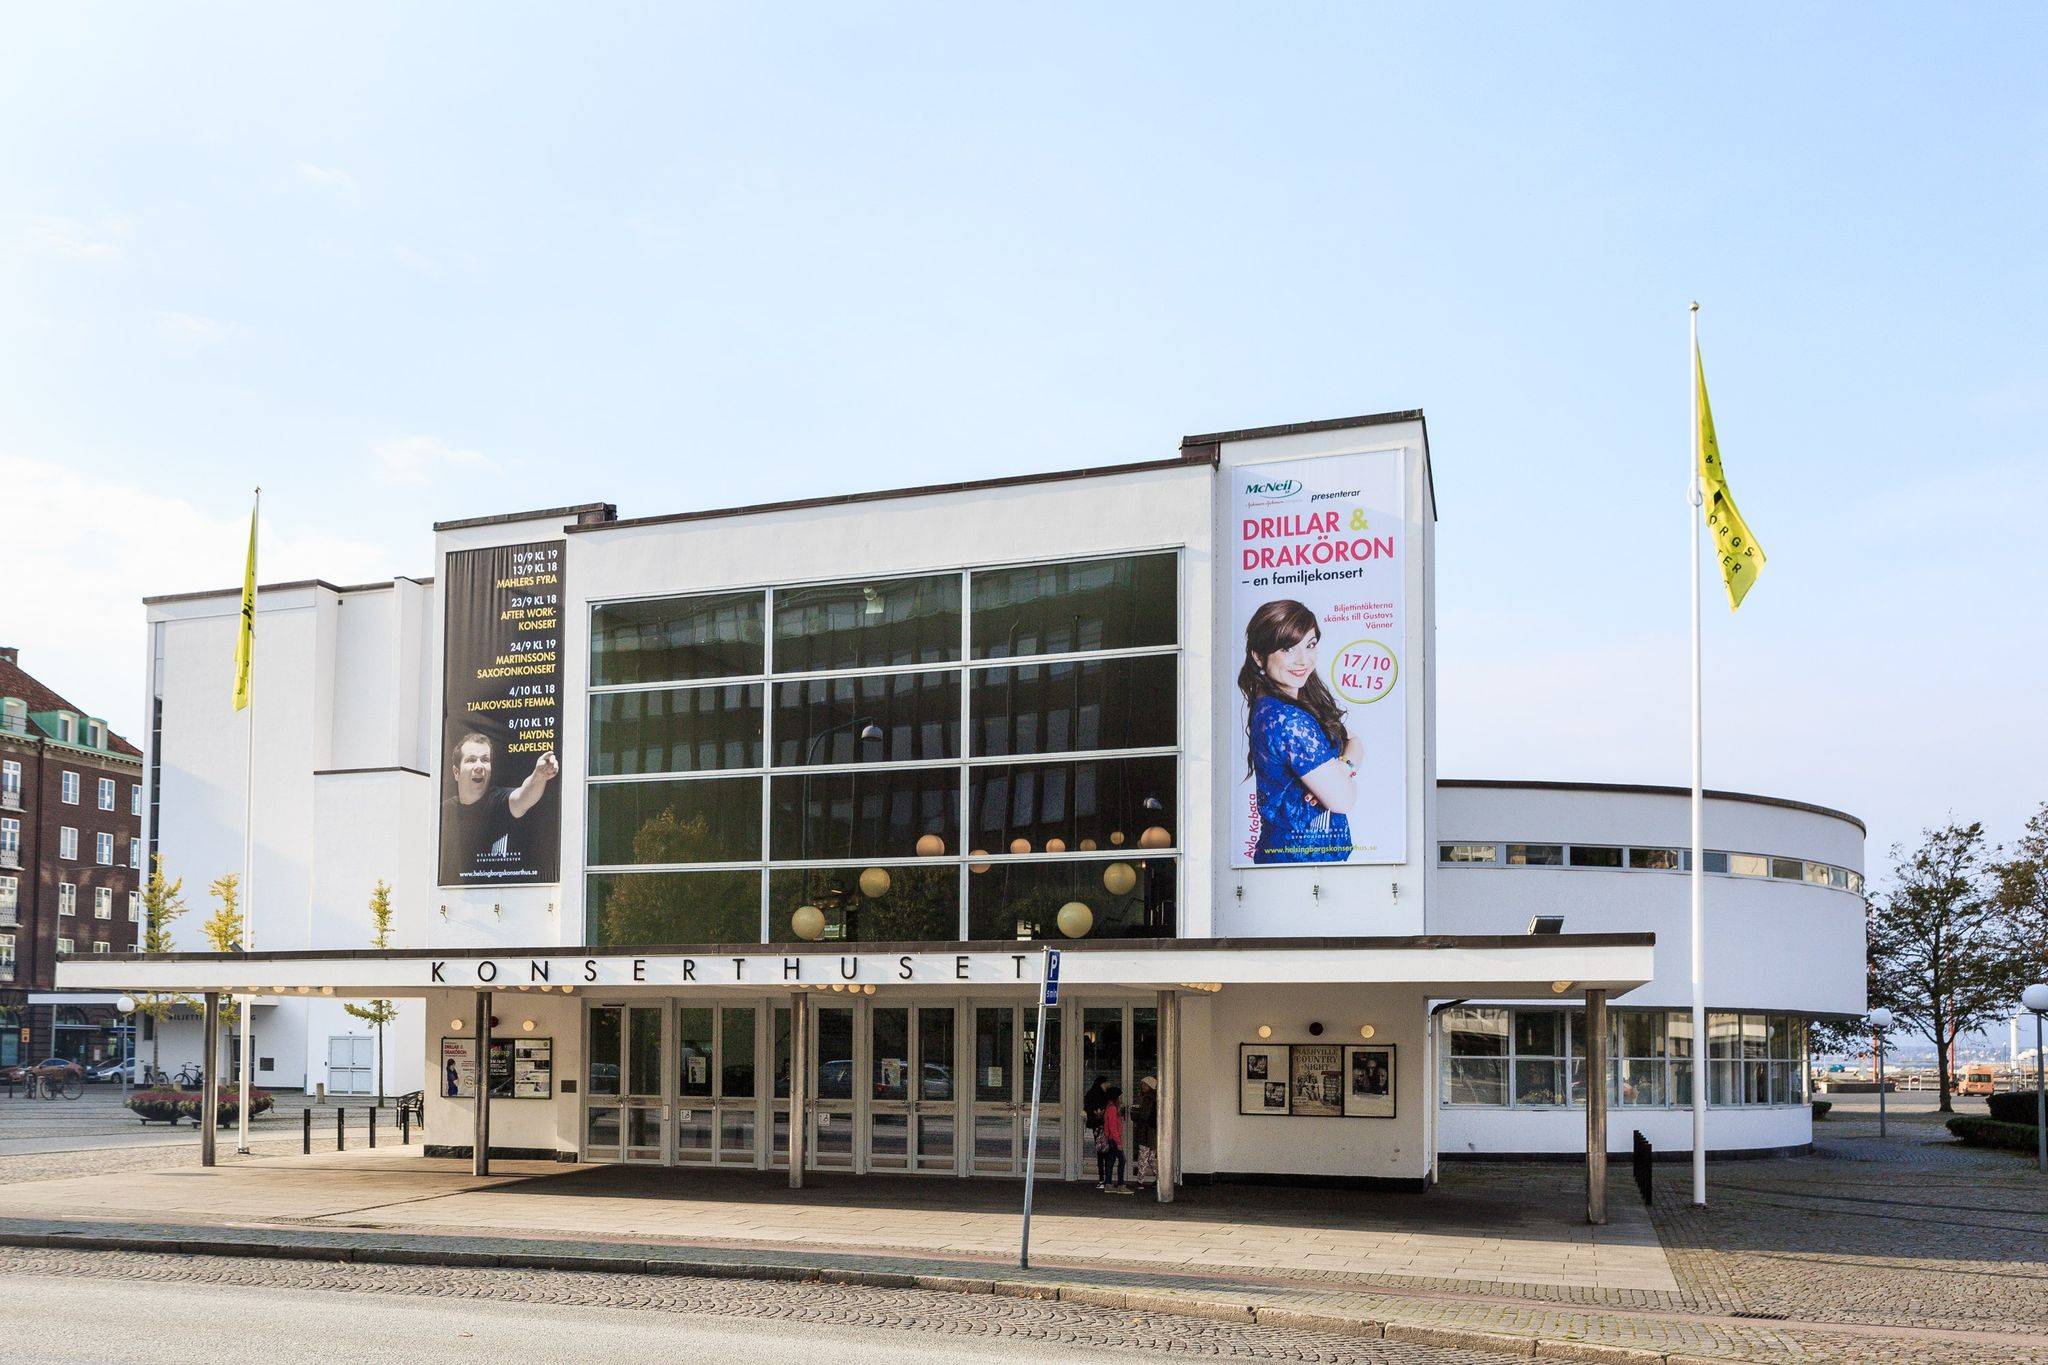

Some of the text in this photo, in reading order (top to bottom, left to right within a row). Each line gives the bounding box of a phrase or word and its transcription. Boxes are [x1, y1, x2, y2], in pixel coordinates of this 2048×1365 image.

[1246, 480, 1292, 494] McNeil
[1311, 490, 1361, 502] presenterar
[1243, 508, 1368, 540] DRILLAR &
[513, 550, 558, 563] 10/9 KL 19
[1243, 534, 1394, 571] DRAKÖRON
[513, 562, 557, 575] 13/9 KL 18
[496, 574, 557, 588] MAHLERS FYRA
[1253, 577, 1268, 586] en
[1272, 568, 1364, 585] familjekonsert
[512, 594, 557, 608] 23/9 KL 18
[500, 607, 557, 620] AFTER WORK-
[1334, 603, 1393, 613] Biljettintäkterna
[1324, 613, 1350, 623] skänks
[1363, 611, 1393, 620] Gustavs
[518, 619, 557, 631] KONSERT
[1366, 621, 1393, 630] Vänner
[510, 639, 556, 652] 24/9 KL 19
[496, 652, 556, 665] MARTINSSONS
[1344, 654, 1391, 671] 17/10
[477, 664, 556, 679] SAXOFONKONSERT
[509, 684, 555, 697] 4/10 KL 18
[467, 697, 555, 711] TJAJKOVSKIJS FEMMA
[508, 717, 554, 729] 8/10 KL 19
[520, 729, 554, 739] HAYDNS
[508, 742, 554, 753] SKAPELSEN
[1244, 794, 1259, 858] Ayla Kabaca
[431, 956, 1026, 983] KONSERTHUSET
[1050, 954, 1058, 978] P
